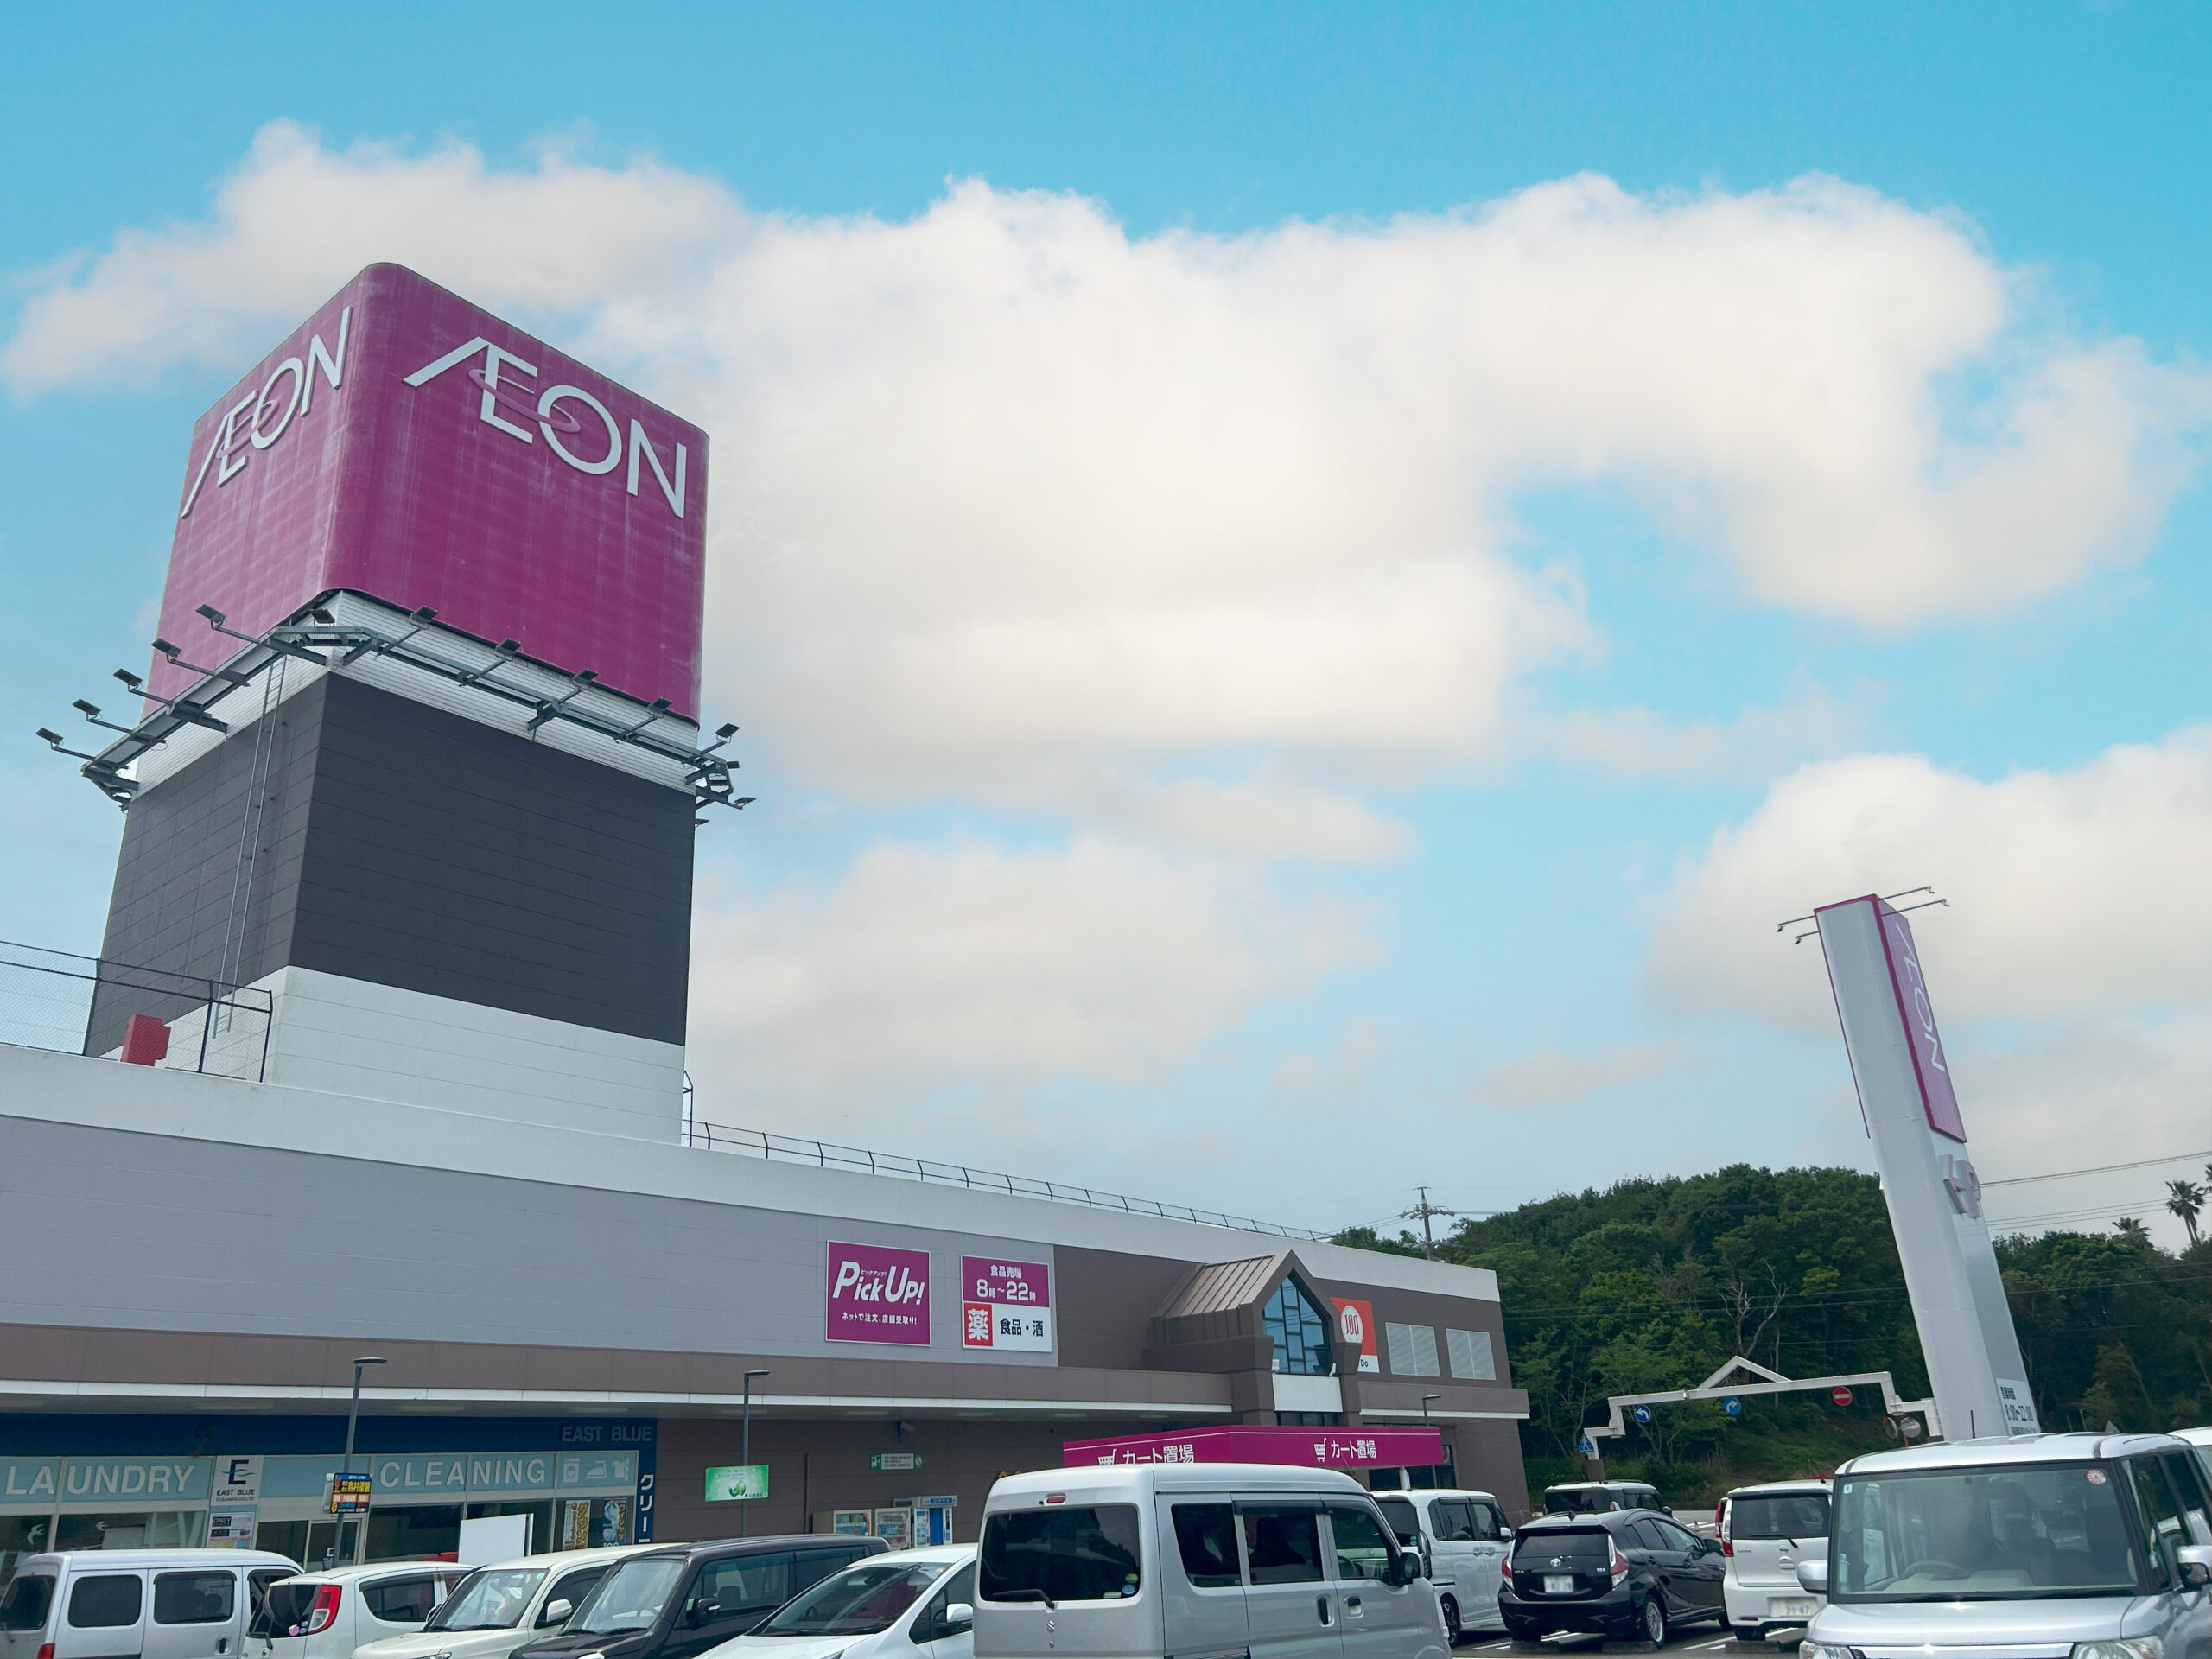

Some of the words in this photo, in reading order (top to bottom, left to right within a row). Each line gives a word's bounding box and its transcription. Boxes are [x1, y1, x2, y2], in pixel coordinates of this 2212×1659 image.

[990, 1264, 1021, 1279] 食品売場
[968, 1308, 989, 1340] 薬
[1000, 1318, 1044, 1337] 食品・酒
[1344, 1314, 1359, 1335] 100
[562, 1426, 603, 1441] EAST
[611, 1426, 652, 1441] BLUE
[1331, 1440, 1376, 1459] カート置場
[5, 1465, 194, 1495] LAUNDRY
[380, 1459, 544, 1487] CLEANING
